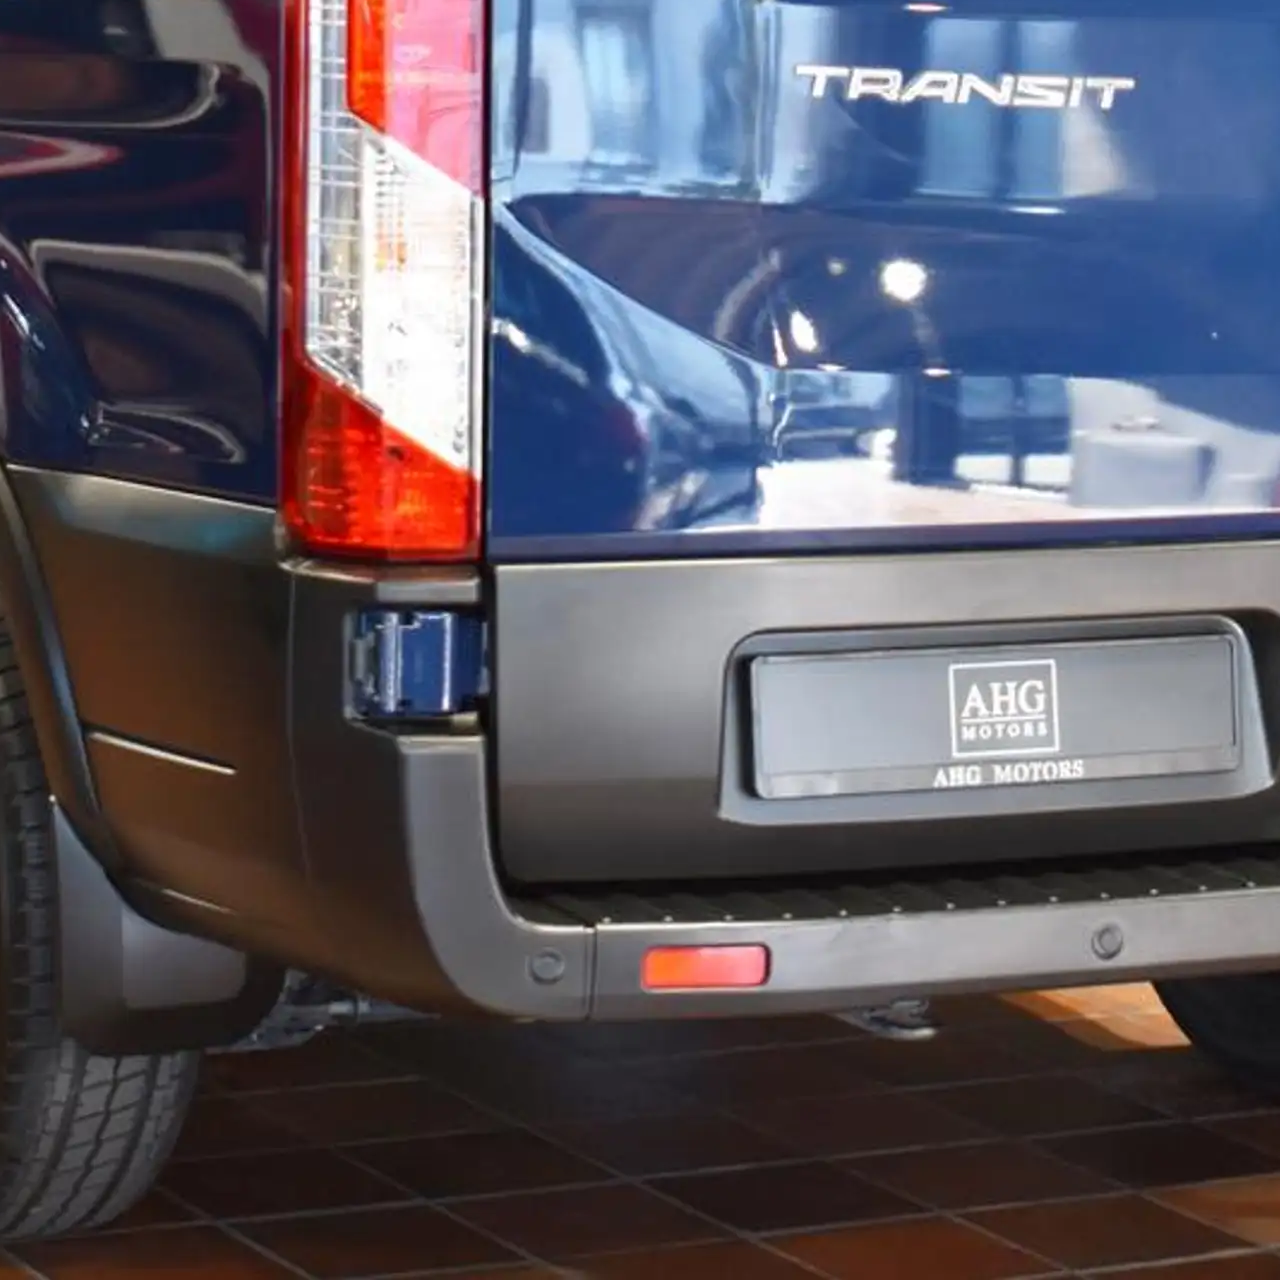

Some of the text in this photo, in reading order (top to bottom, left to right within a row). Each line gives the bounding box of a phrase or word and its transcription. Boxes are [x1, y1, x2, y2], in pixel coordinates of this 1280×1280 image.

[796, 65, 1135, 110] TRANSIT
[961, 680, 1046, 717] AHG
[962, 722, 1048, 740] MOTORS
[933, 759, 1085, 788] AHG MOTORS
